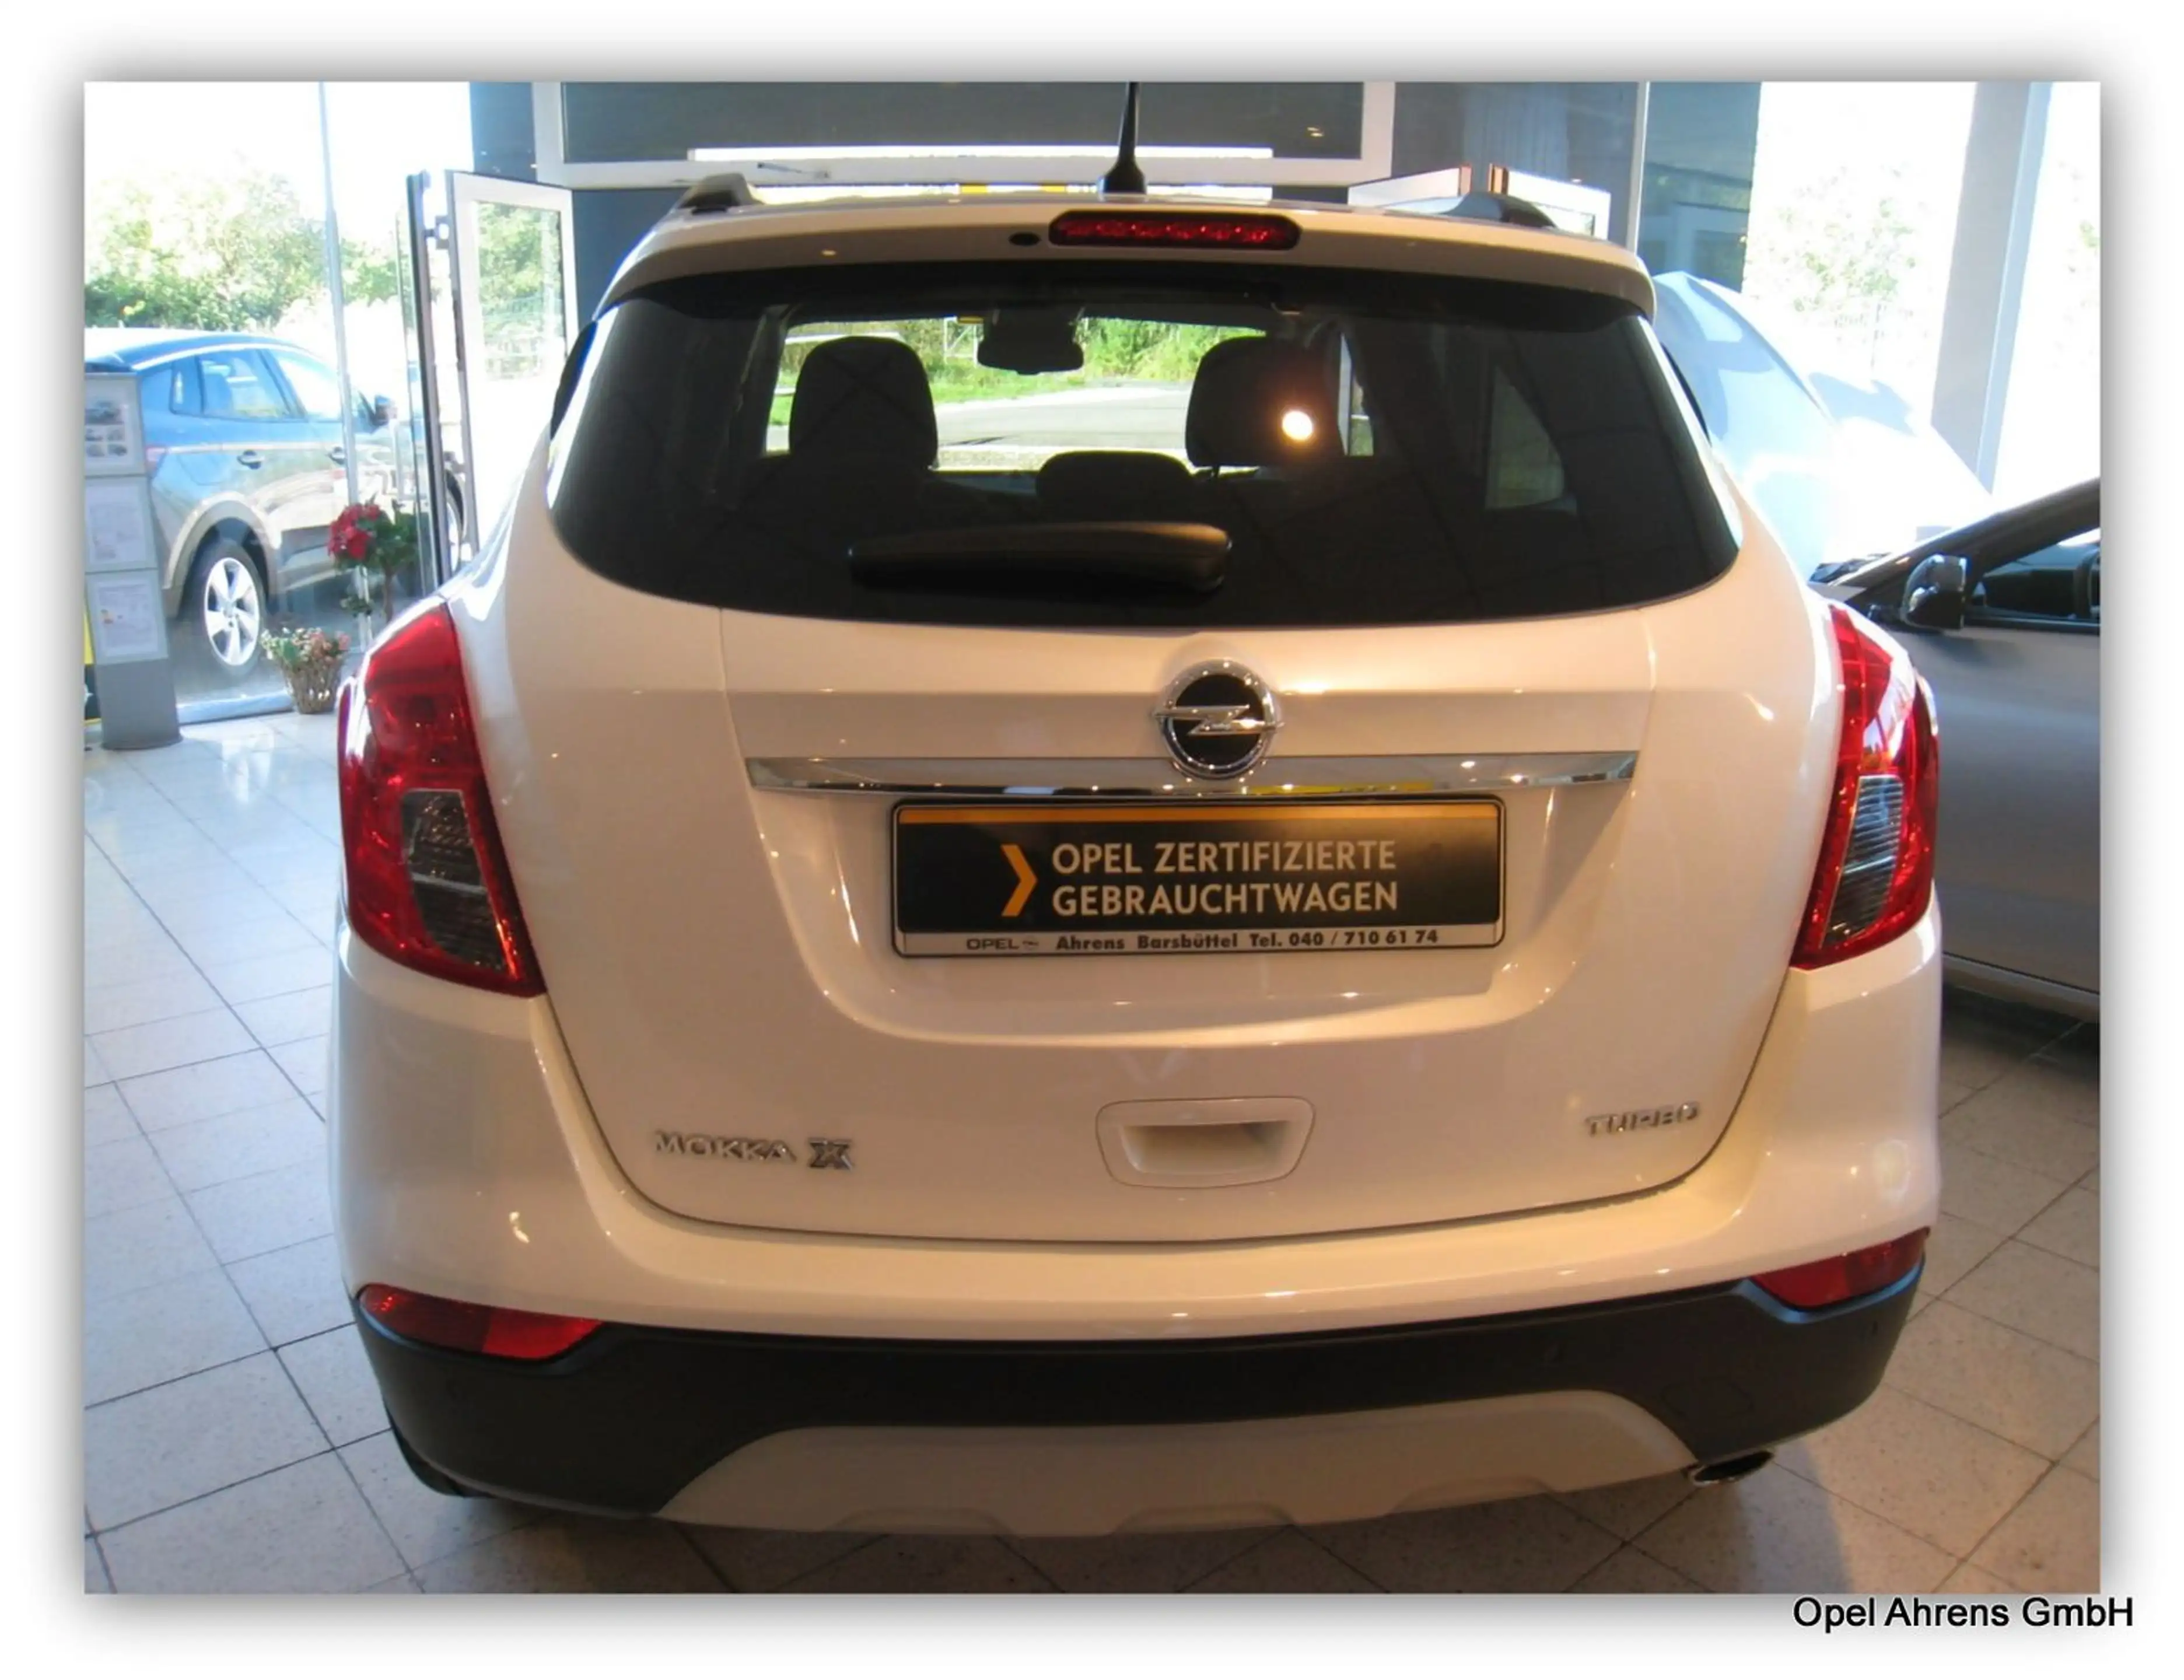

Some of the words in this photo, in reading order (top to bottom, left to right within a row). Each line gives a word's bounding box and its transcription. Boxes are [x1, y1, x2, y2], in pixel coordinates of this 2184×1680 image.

[1052, 842, 1142, 874] OPEL
[1154, 840, 1396, 873] ZERTIFIZIERTE
[1052, 881, 1398, 916] GEBRAUCHTWAGEN
[966, 938, 1020, 951] OPEL
[1056, 935, 1125, 950] Ahrens
[1137, 932, 1238, 949] Barsbüttel
[1249, 933, 1282, 948] Tel.
[1289, 933, 1324, 947] 040
[1330, 932, 1338, 946] /
[1343, 931, 1380, 945] 710
[1385, 930, 1407, 944] 61
[1415, 929, 1438, 944] 74
[1585, 1101, 1700, 1138] TURBO
[655, 1129, 797, 1163] MOKKA
[807, 1138, 856, 1170] X
